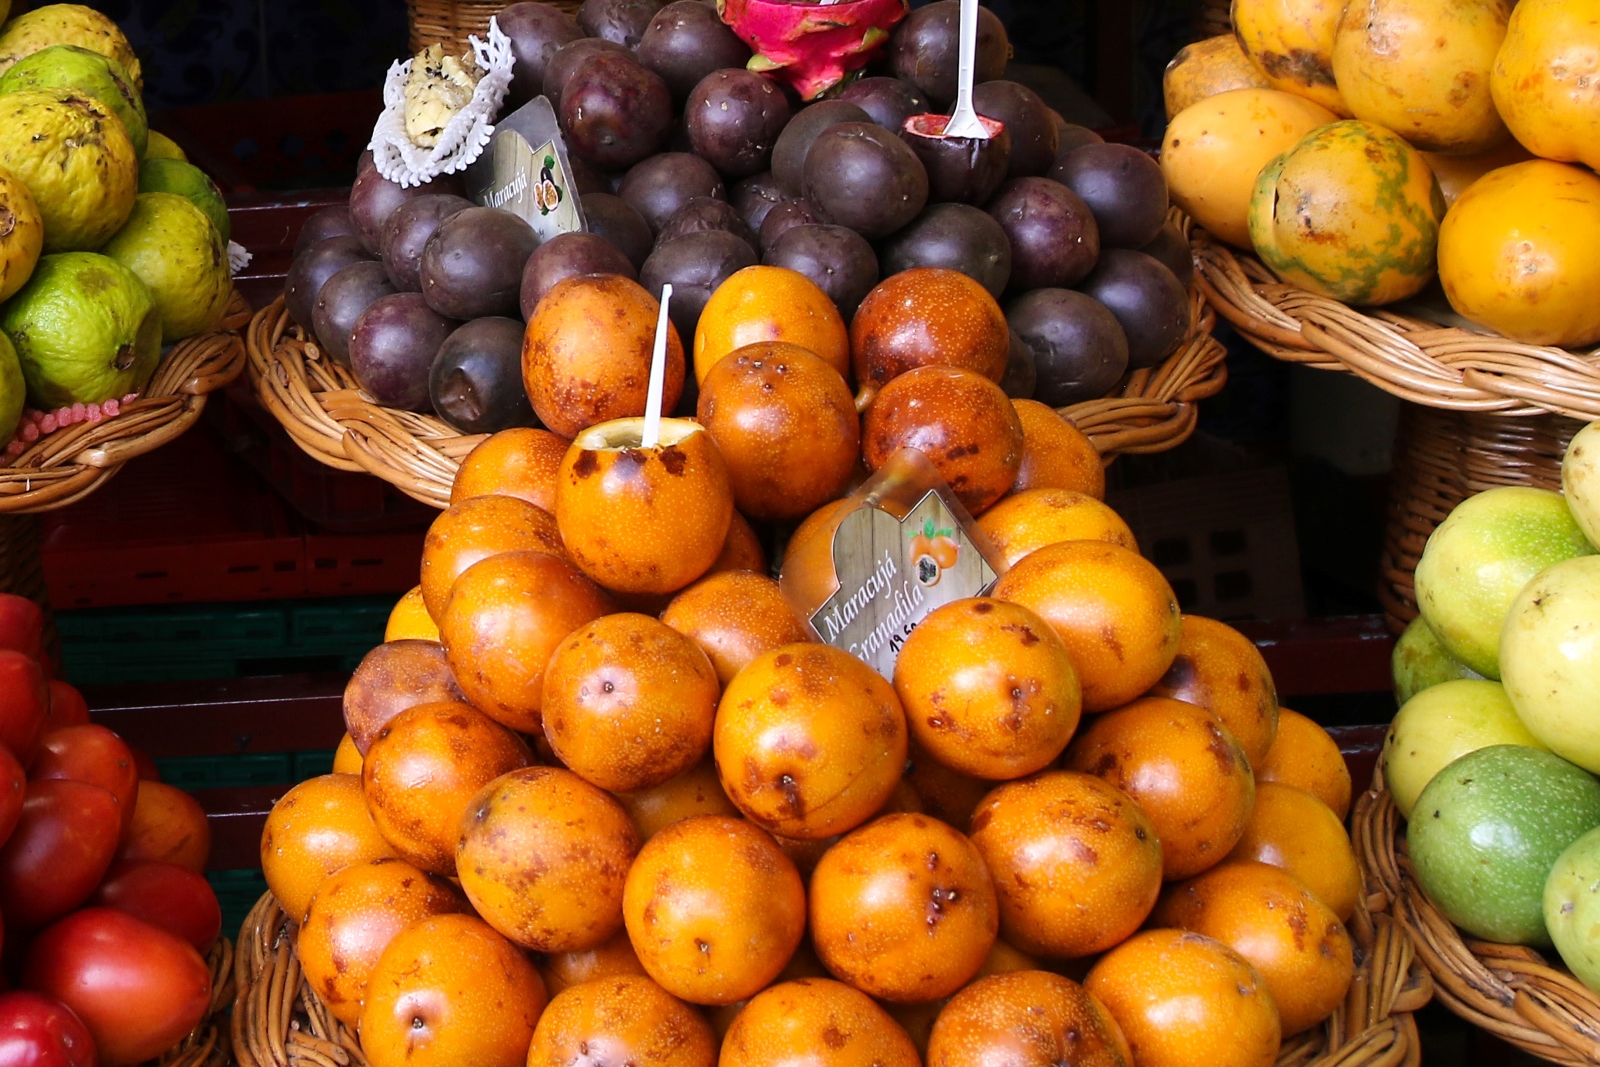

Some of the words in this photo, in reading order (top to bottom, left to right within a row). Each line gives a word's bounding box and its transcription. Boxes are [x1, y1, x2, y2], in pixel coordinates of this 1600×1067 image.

[483, 166, 528, 208] Maracujá
[822, 549, 898, 642] Maracujá
[849, 580, 924, 662] Granadila
